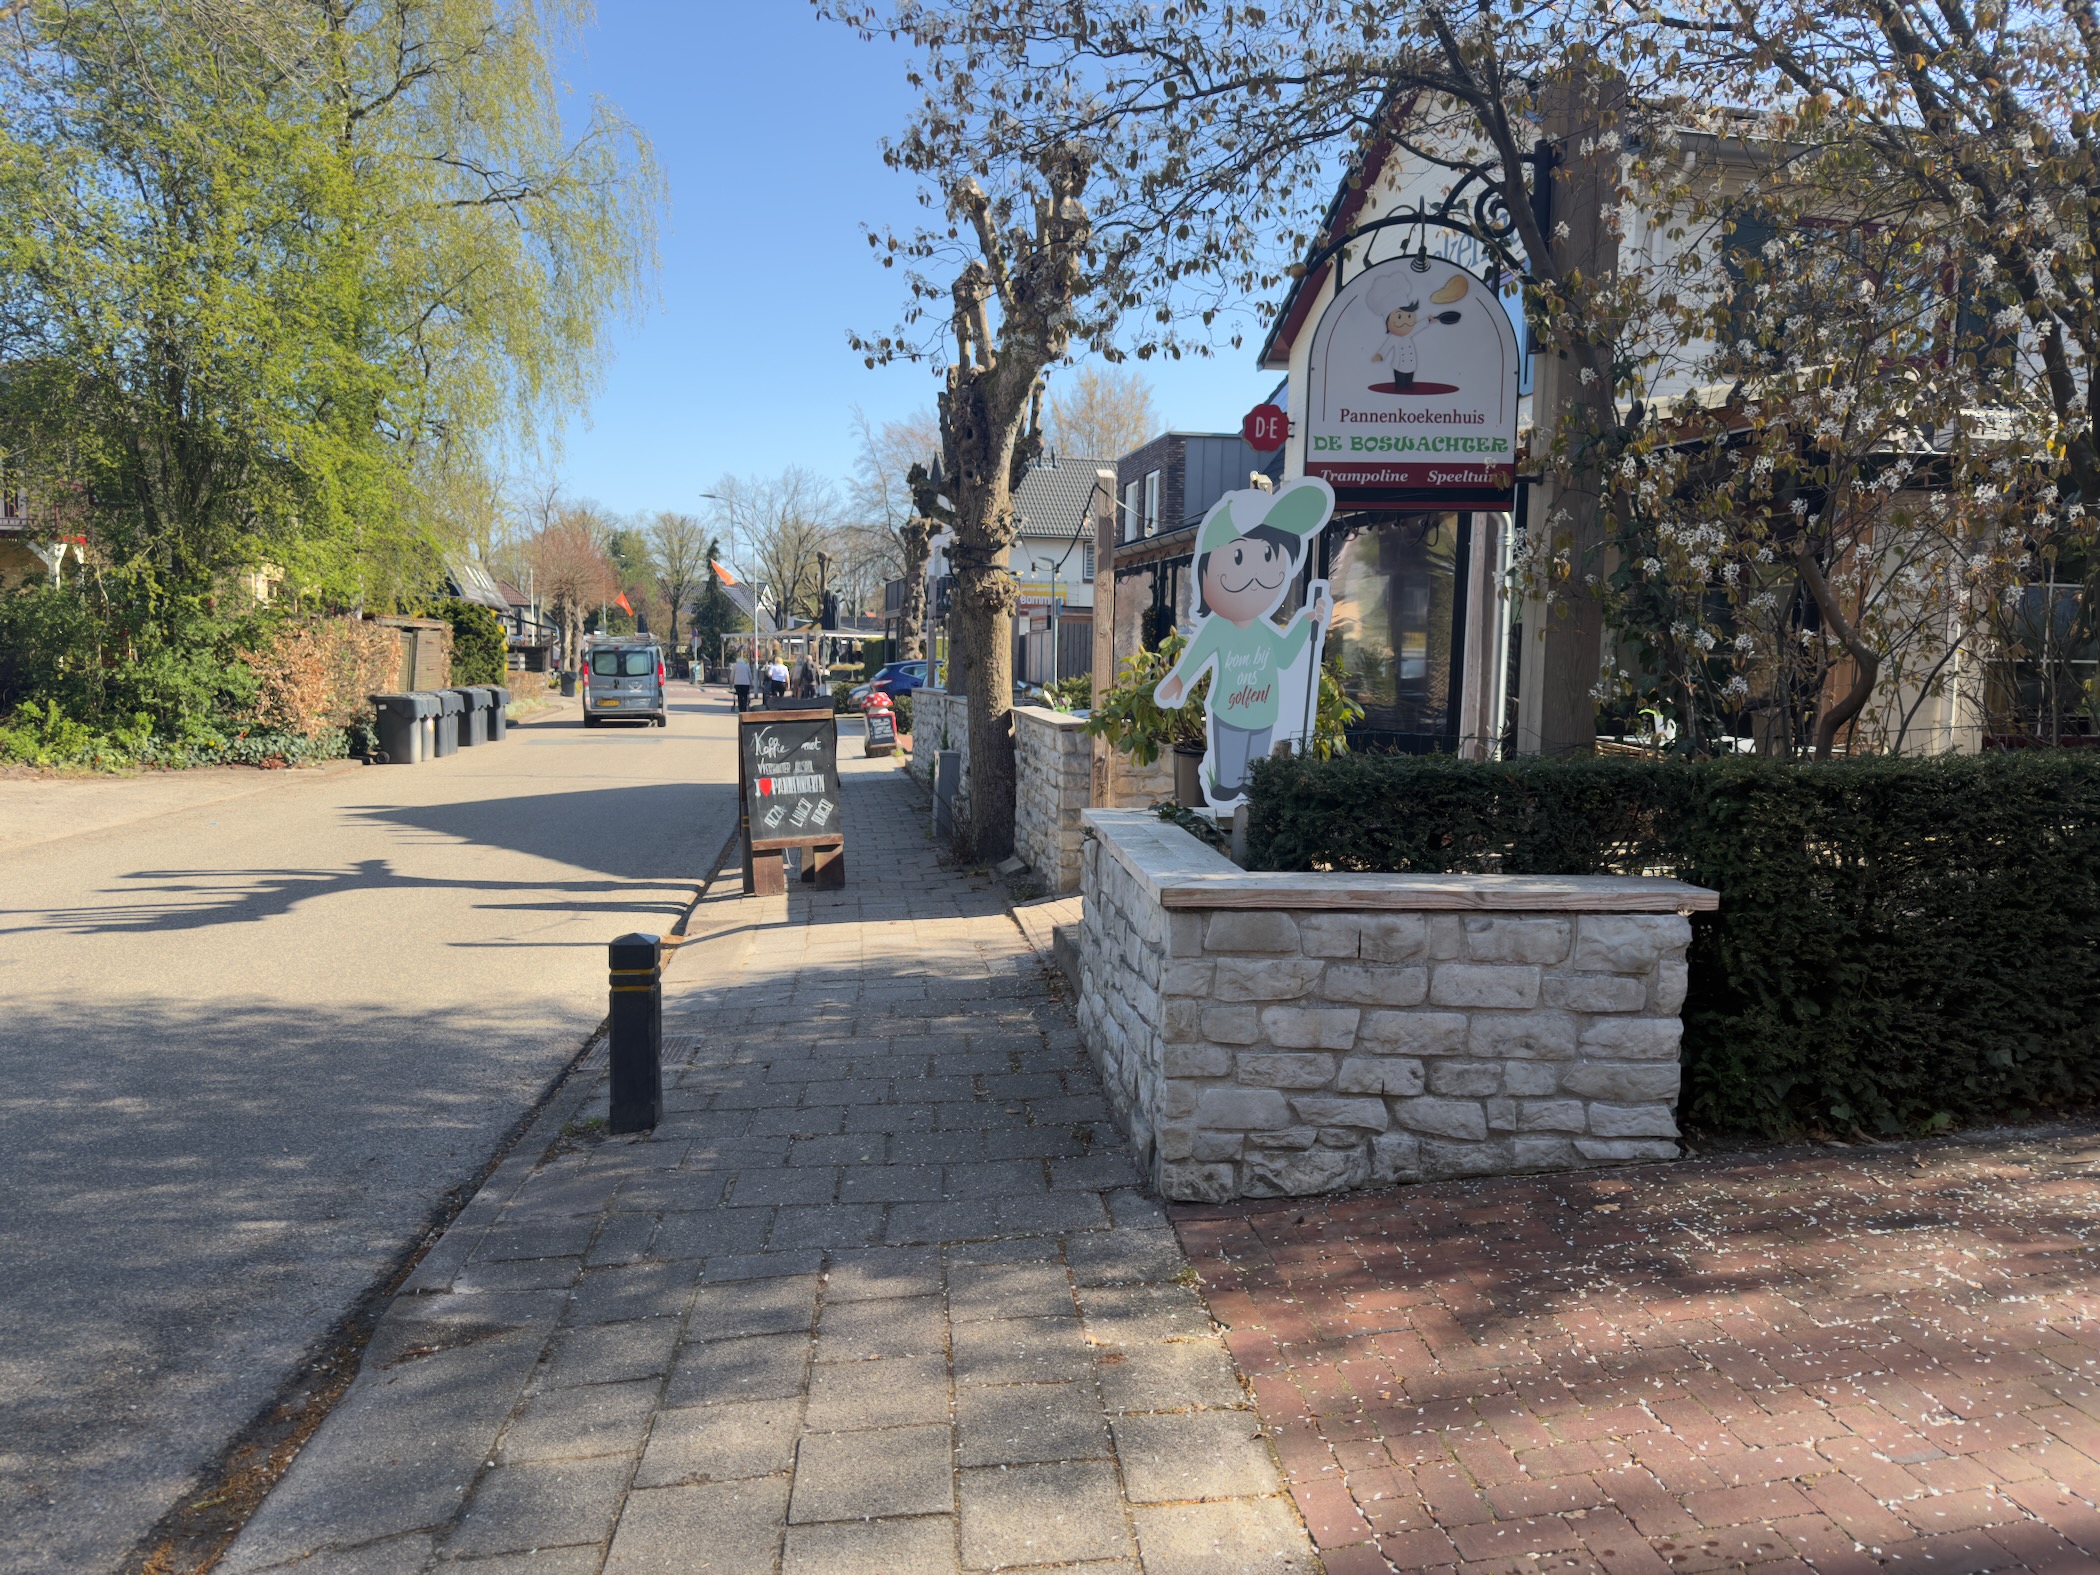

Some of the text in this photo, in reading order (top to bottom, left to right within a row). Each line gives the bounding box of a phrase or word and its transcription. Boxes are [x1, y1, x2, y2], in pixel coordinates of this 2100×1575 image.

[1340, 408, 1485, 424] Pannenkoekenhuis
[1313, 435, 1509, 453] DE BOSWACHTER
[1321, 469, 1409, 485] Trampoline
[1224, 645, 1271, 672] kom bij
[1236, 670, 1258, 686] ons
[1227, 683, 1271, 711] golfen!
[750, 726, 821, 758] Koffie met
[789, 797, 813, 827] LUNCH
